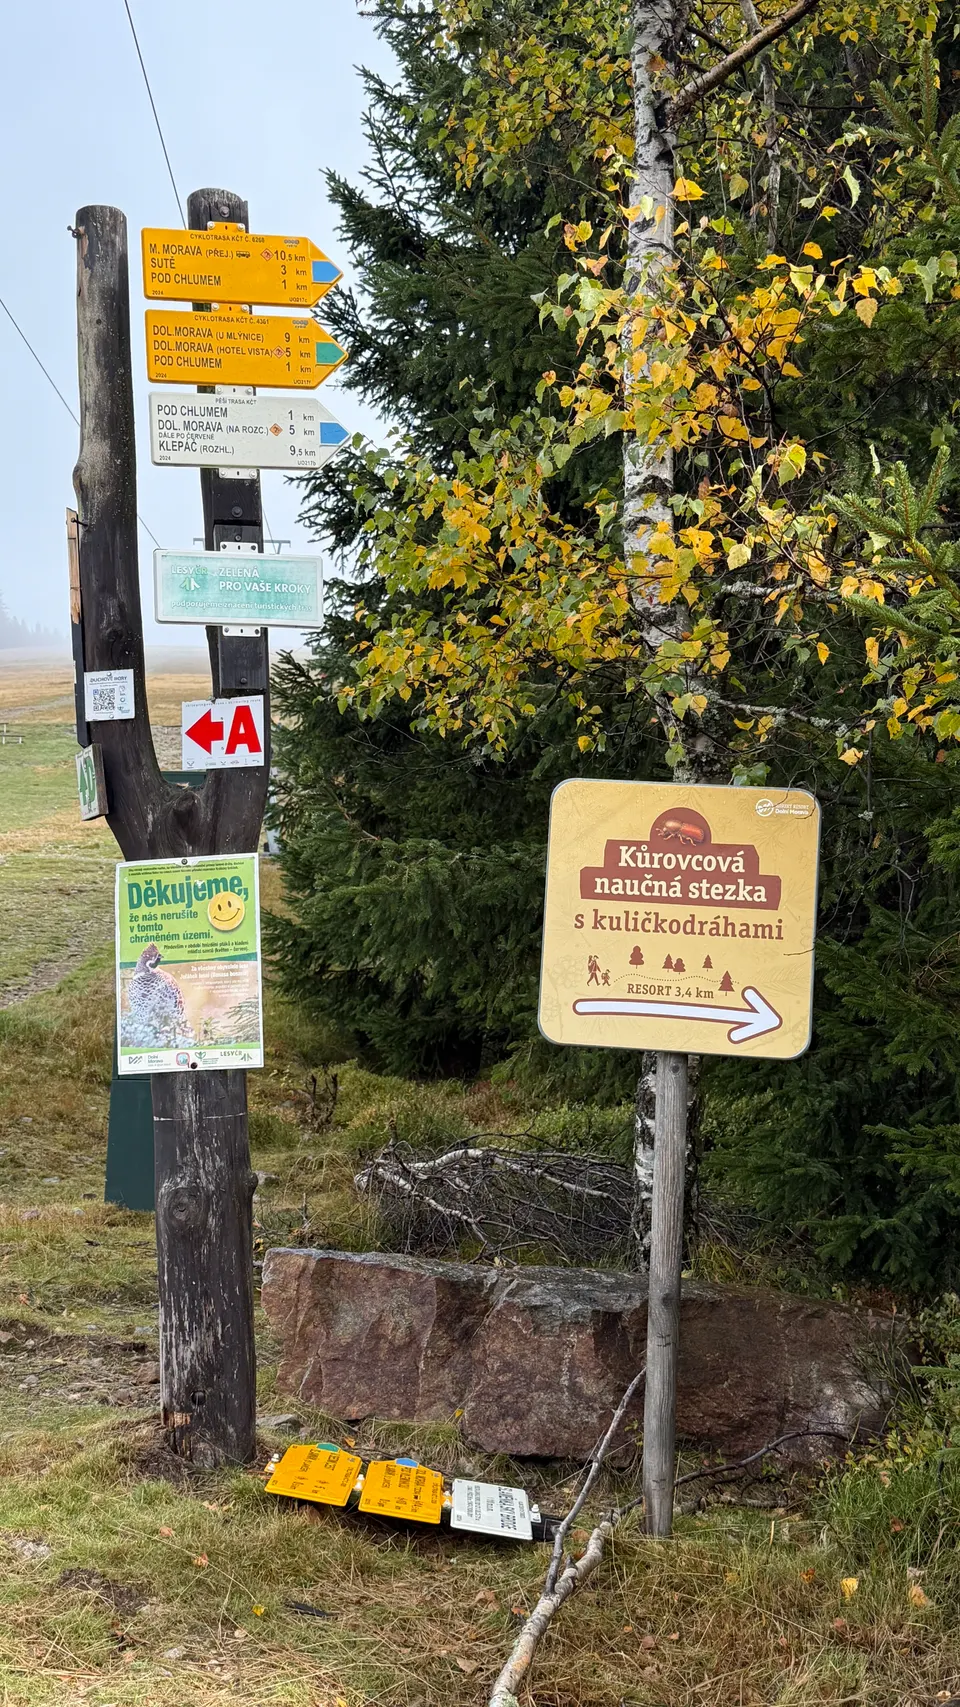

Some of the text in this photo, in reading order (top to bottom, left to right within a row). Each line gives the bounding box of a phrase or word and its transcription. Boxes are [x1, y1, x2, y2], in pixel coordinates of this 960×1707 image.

[190, 233, 230, 242] CYKLOTRASA
[232, 235, 243, 243] KČT
[149, 244, 160, 255] M.
[163, 244, 201, 256] MORAVA
[206, 249, 234, 260] (PŘEJ.)
[294, 254, 306, 262] km
[151, 256, 307, 276] SUTĚ 3 km
[151, 272, 308, 291] POD CHLUMEM 1 km
[194, 315, 235, 323] CYKLOTRASA
[236, 316, 248, 324] KČT
[153, 326, 310, 344] DOL.MORAVA (U MLÝNICE) 9 km
[153, 341, 311, 359] DOL.MORAVA (HOTEL VISTA) 5 km
[154, 356, 311, 374] POD CHLUMEM 1 km
[158, 405, 314, 422] POD CHLUMEM 1 km
[158, 420, 181, 431] DOL.
[183, 420, 223, 433] MORAVA
[226, 426, 240, 434] (NA
[242, 426, 269, 436] ROZC.)
[289, 425, 295, 435] 5
[186, 431, 215, 441] ČERVENÉ
[159, 439, 316, 457] KLEPÁČ (ROZHL.) 9,5 km
[219, 566, 260, 578] ZELENÁ
[220, 581, 311, 594] PRO VAŠE KROKY
[172, 600, 222, 610] podporujeme
[225, 705, 262, 755] A
[619, 845, 745, 873] Kůrovcová
[128, 875, 249, 910] Děkujeme,
[594, 875, 767, 902] naučná stezka
[129, 913, 140, 923] že
[142, 912, 158, 921] nás
[574, 909, 784, 940] s kuličkodráhami
[137, 922, 163, 932] tomto
[130, 929, 214, 944] chráněném území.
[627, 983, 714, 999] RESORT 3,4 km
